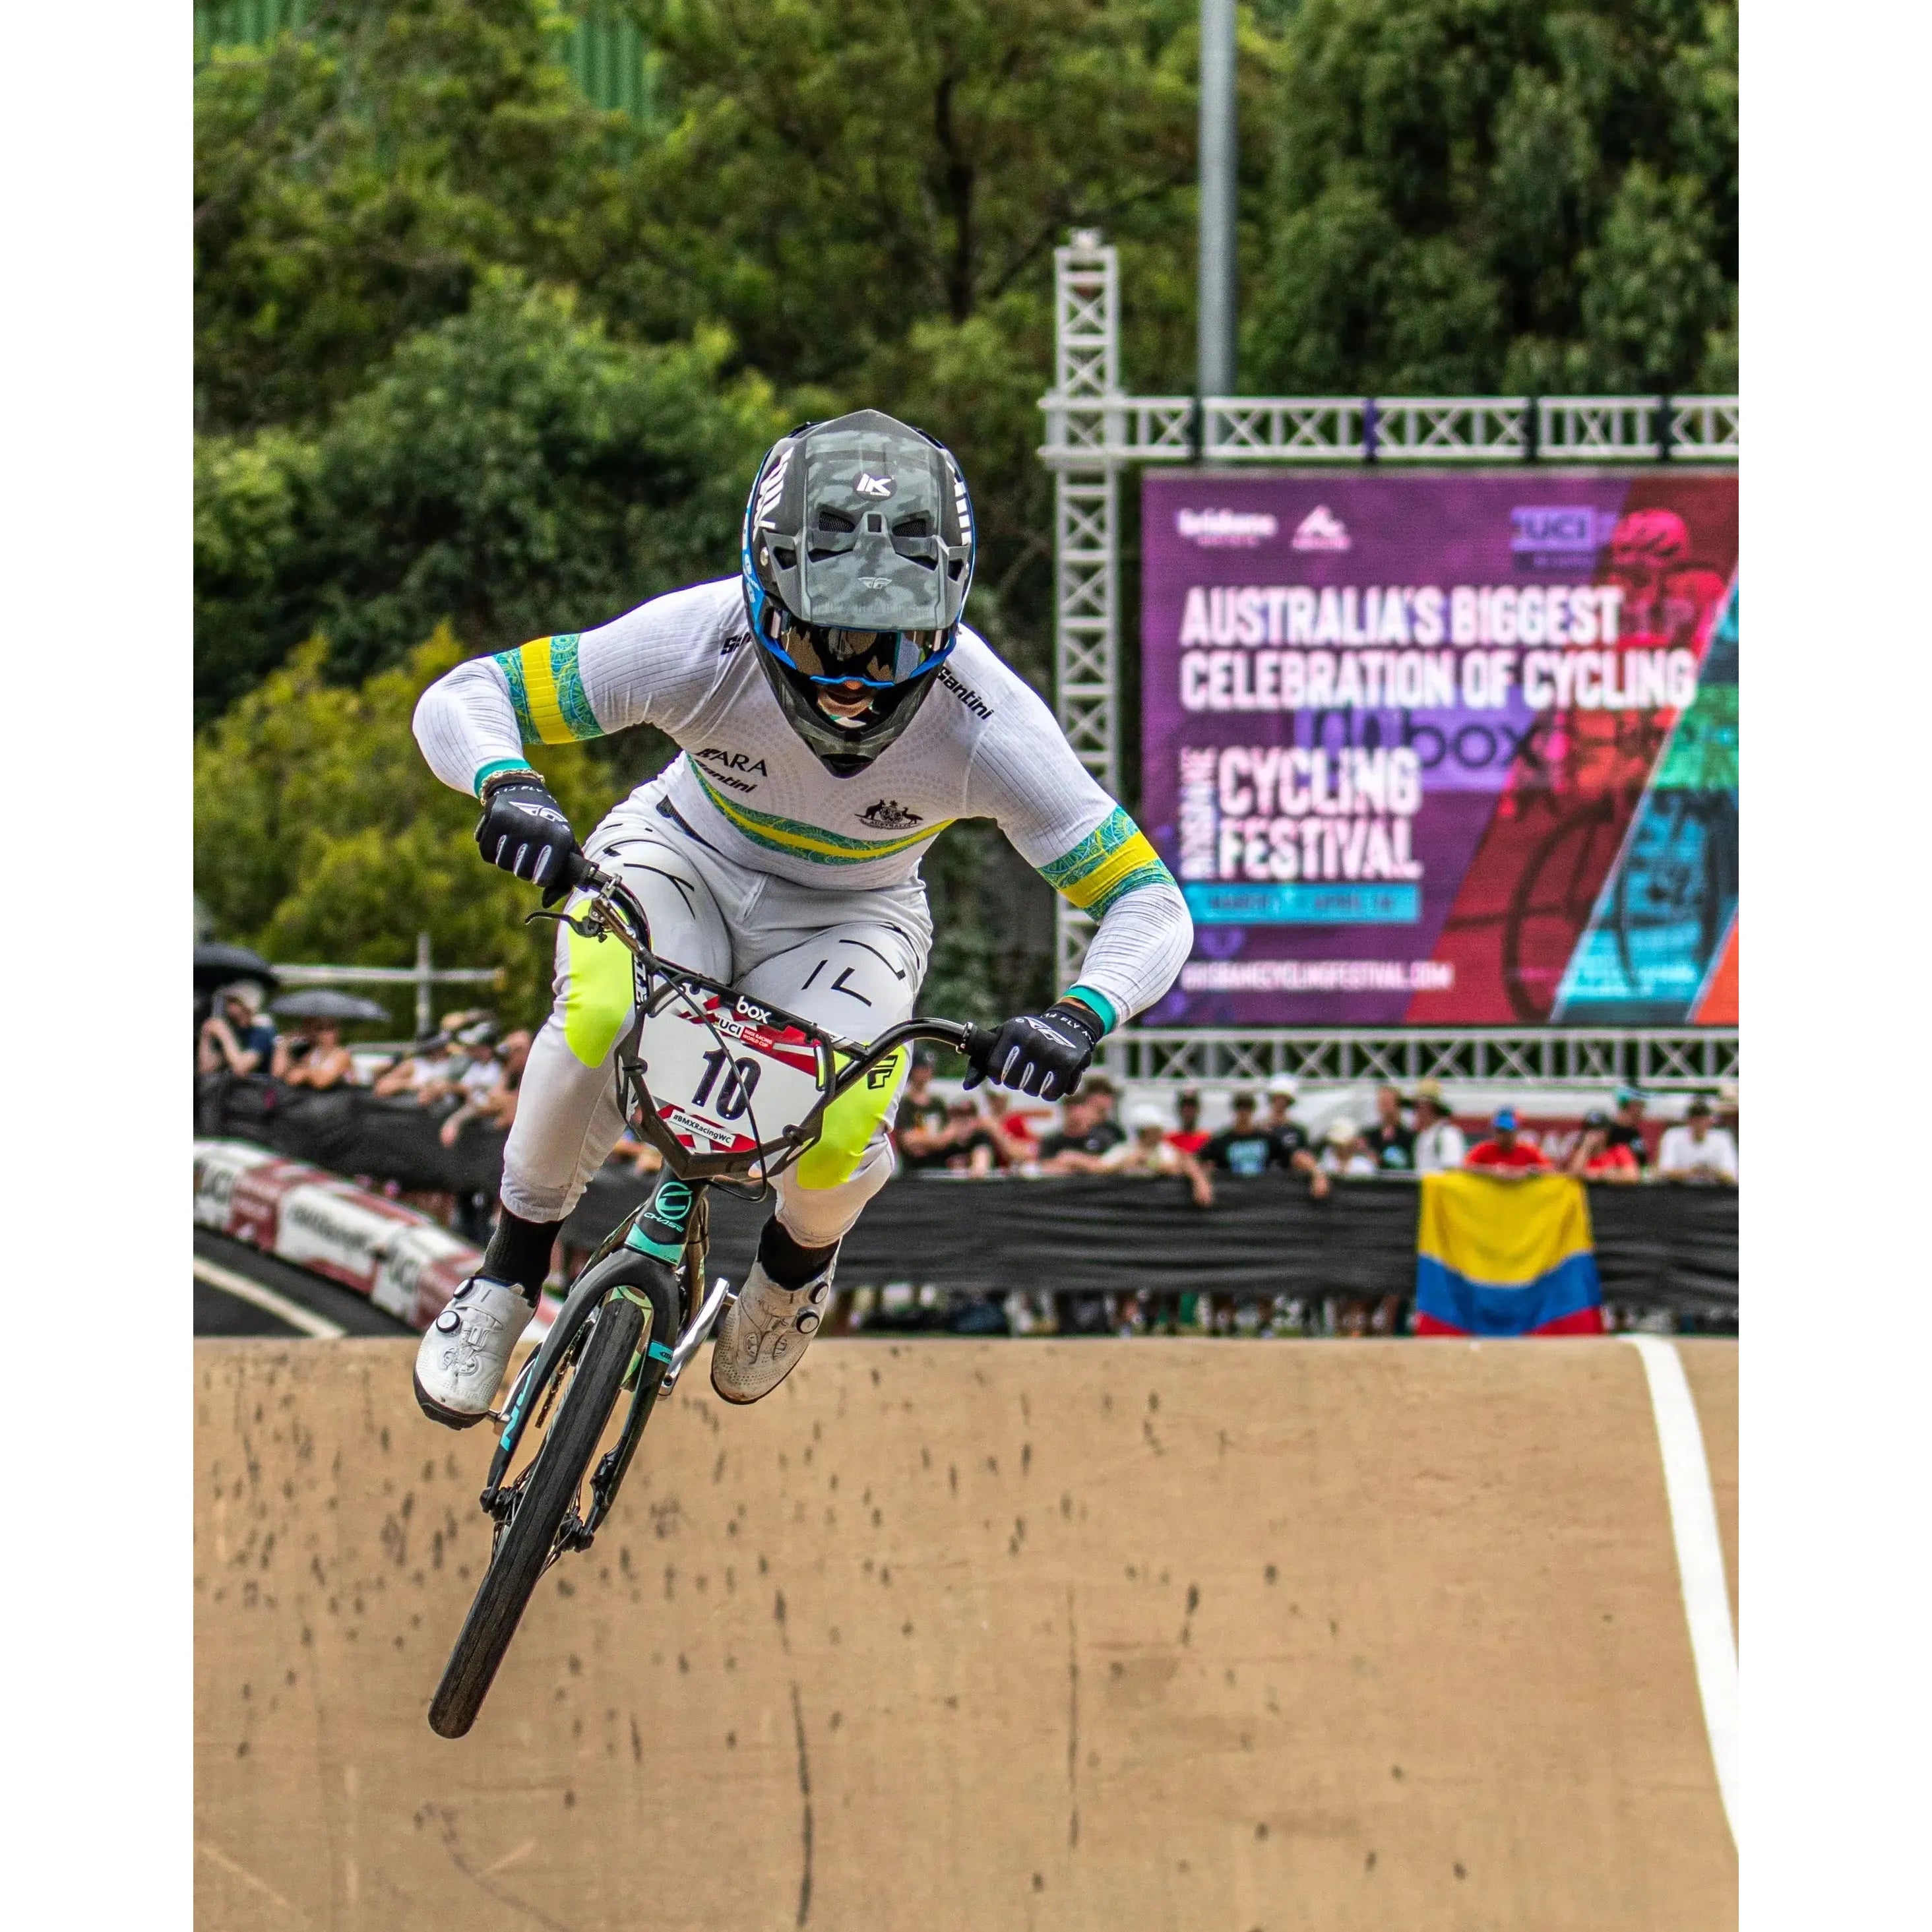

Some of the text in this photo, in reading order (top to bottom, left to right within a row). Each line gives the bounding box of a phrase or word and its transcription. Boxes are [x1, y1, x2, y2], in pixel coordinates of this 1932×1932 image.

[1181, 586, 1444, 647] AUSTRALIA'S
[1450, 586, 1624, 647] BIGGEST
[937, 666, 994, 720] Santini
[1181, 650, 1698, 711] CELEBRATION OF CYCLING
[1218, 746, 1422, 817] CYCLING
[1219, 818, 1423, 880] FESTIVAL
[720, 1019, 741, 1035] UCI
[737, 996, 771, 1024] box
[691, 1049, 761, 1120] 10
[673, 1114, 732, 1144] #BMXRacingWC
